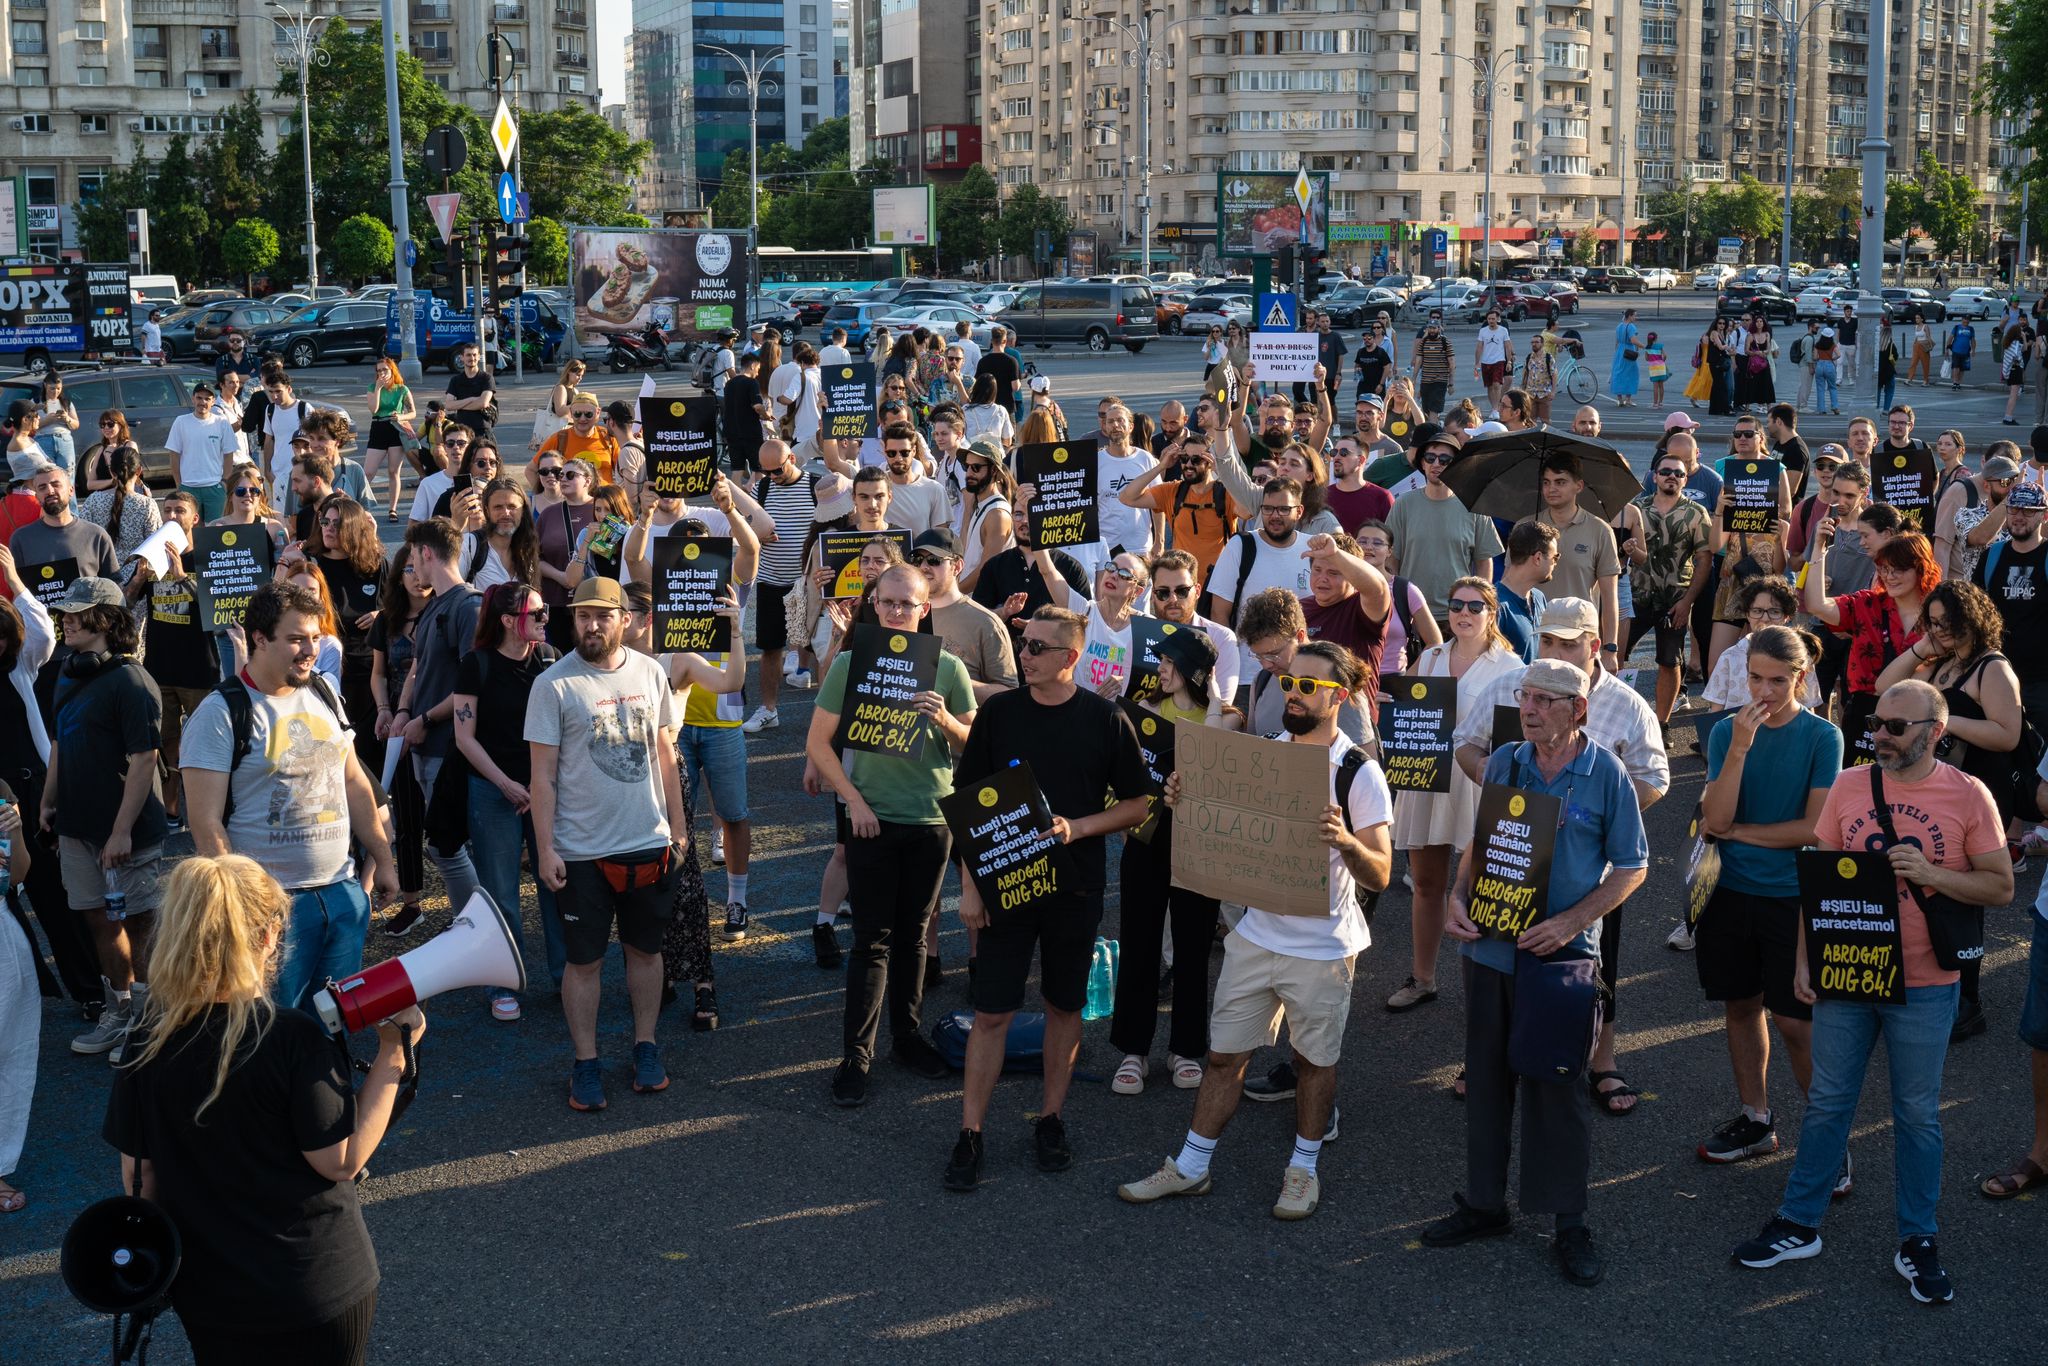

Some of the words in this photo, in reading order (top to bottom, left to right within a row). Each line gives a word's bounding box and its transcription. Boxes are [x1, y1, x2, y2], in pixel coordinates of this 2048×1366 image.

[1436, 234, 1444, 250] P
[701, 246, 726, 255] ARDEALUL
[89, 285, 127, 296] GRATUITE
[691, 290, 737, 302] FAINOȘAG
[26, 315, 70, 323] ROMANIA
[90, 319, 130, 338] TOPX
[450, 324, 471, 334] perfect
[45, 336, 78, 344] ROMANI
[1252, 353, 1317, 361] EVIDENCE-BASED
[831, 384, 849, 393] Luați
[832, 391, 844, 399] din
[844, 391, 865, 399] pensii
[834, 398, 865, 406] speciale,
[852, 404, 873, 413] șoferi
[833, 414, 866, 426] ABROGAȚI
[831, 425, 850, 436] OUG
[850, 422, 868, 436] 84!
[656, 431, 688, 443] #ȘIEU
[688, 430, 705, 440] iau
[649, 439, 713, 453] paracetamol
[656, 456, 711, 475] ABROGAȚI
[655, 476, 685, 493] OUG
[686, 467, 713, 493] 84!
[1038, 471, 1062, 483] Luați
[1063, 469, 1086, 480] banii
[1733, 478, 1752, 487] Luați
[1881, 474, 1902, 483] Luați
[1902, 472, 1922, 481] banii
[1040, 482, 1055, 492] din
[1056, 479, 1084, 491] pensii
[1883, 483, 1896, 491] din
[1896, 481, 1921, 491] pensii
[1041, 489, 1082, 503] speciale,
[1885, 490, 1920, 499] speciale,
[1898, 498, 1906, 506] la
[1906, 496, 1930, 506] șoferi
[1032, 505, 1044, 513] nu
[1044, 502, 1056, 511] de
[1057, 500, 1066, 510] la
[1066, 496, 1093, 510] șoferi
[1754, 500, 1775, 508] șoferi
[1042, 511, 1084, 529] ABROGAȚI
[1733, 510, 1767, 521] ABROGAȚI
[1731, 519, 1750, 530] OUG
[1750, 518, 1768, 531] 84!
[1040, 527, 1064, 545] OUG
[1064, 522, 1086, 543] 84!
[209, 549, 234, 560] Copiii
[234, 548, 252, 557] mei
[208, 558, 236, 569] rămân
[236, 557, 255, 566] fără
[202, 567, 240, 578] mâncare
[240, 566, 263, 575] dacă
[666, 569, 692, 581] Luați
[693, 569, 719, 579] banii
[37, 580, 65, 592] #ȘIEU
[225, 575, 253, 585] rămân
[667, 580, 684, 590] din
[684, 580, 716, 592] pensii
[209, 585, 228, 595] fără
[228, 583, 258, 595] permis
[2001, 586, 2036, 597] TUPAC
[669, 591, 714, 602] speciale,
[657, 604, 670, 612] nu
[671, 602, 684, 612] de
[685, 602, 695, 612] la
[667, 617, 715, 633] ABROGAȚI
[664, 632, 690, 649] OUG
[690, 629, 717, 650] 84!
[876, 656, 914, 673] #ȘIEU
[867, 671, 882, 683] aș
[882, 672, 918, 688] putea
[856, 682, 871, 694] să
[873, 686, 881, 695] o
[855, 702, 921, 732] ABROGAȚI
[1393, 707, 1419, 720] Luați
[1419, 708, 1443, 719] banii
[1394, 719, 1410, 729] din
[1410, 719, 1441, 730] pensii
[847, 720, 884, 746] OUG
[884, 727, 921, 753] 84!
[1394, 730, 1437, 741] speciale,
[1381, 740, 1394, 749] nu
[1395, 740, 1408, 750] de
[1409, 740, 1419, 750] la
[1419, 741, 1449, 752] șoferi
[1178, 733, 1238, 774] OUG
[1250, 751, 1280, 785] 84
[1388, 755, 1437, 772] ABROGAȚI
[1384, 769, 1411, 786] OUG
[1411, 769, 1438, 789] 84!
[1868, 803, 1930, 825] KNVELO
[969, 815, 1002, 839] Luați
[1000, 803, 1031, 824] banii
[1174, 799, 1276, 844] CIOLACU
[1287, 828, 1318, 850] NE
[991, 828, 1008, 843] de
[1006, 824, 1020, 836] la
[1496, 819, 1531, 839] #ȘIEU
[979, 827, 1040, 862] evazioniști
[1488, 832, 1533, 854] mănânc
[976, 865, 994, 877] nu
[993, 856, 1009, 870] de
[1008, 852, 1021, 863] la
[1021, 835, 1056, 860] șoferi
[1486, 848, 1531, 868] cozonac
[997, 855, 1049, 891] ABROGAȚI
[1486, 862, 1500, 875] cu
[1500, 865, 1526, 881] mac
[1001, 882, 1031, 910] OUG
[1031, 867, 1058, 897] 84!
[1475, 876, 1537, 911] ABROGAȚI
[1469, 898, 1497, 929] OUG
[1819, 899, 1861, 916] #ȘIEU
[1862, 900, 1884, 915] iau
[1811, 917, 1896, 933] paracetamol
[1823, 943, 1893, 971] ABROGAȚI
[1820, 966, 1861, 993] OUG
[1862, 965, 1897, 998] 84!
